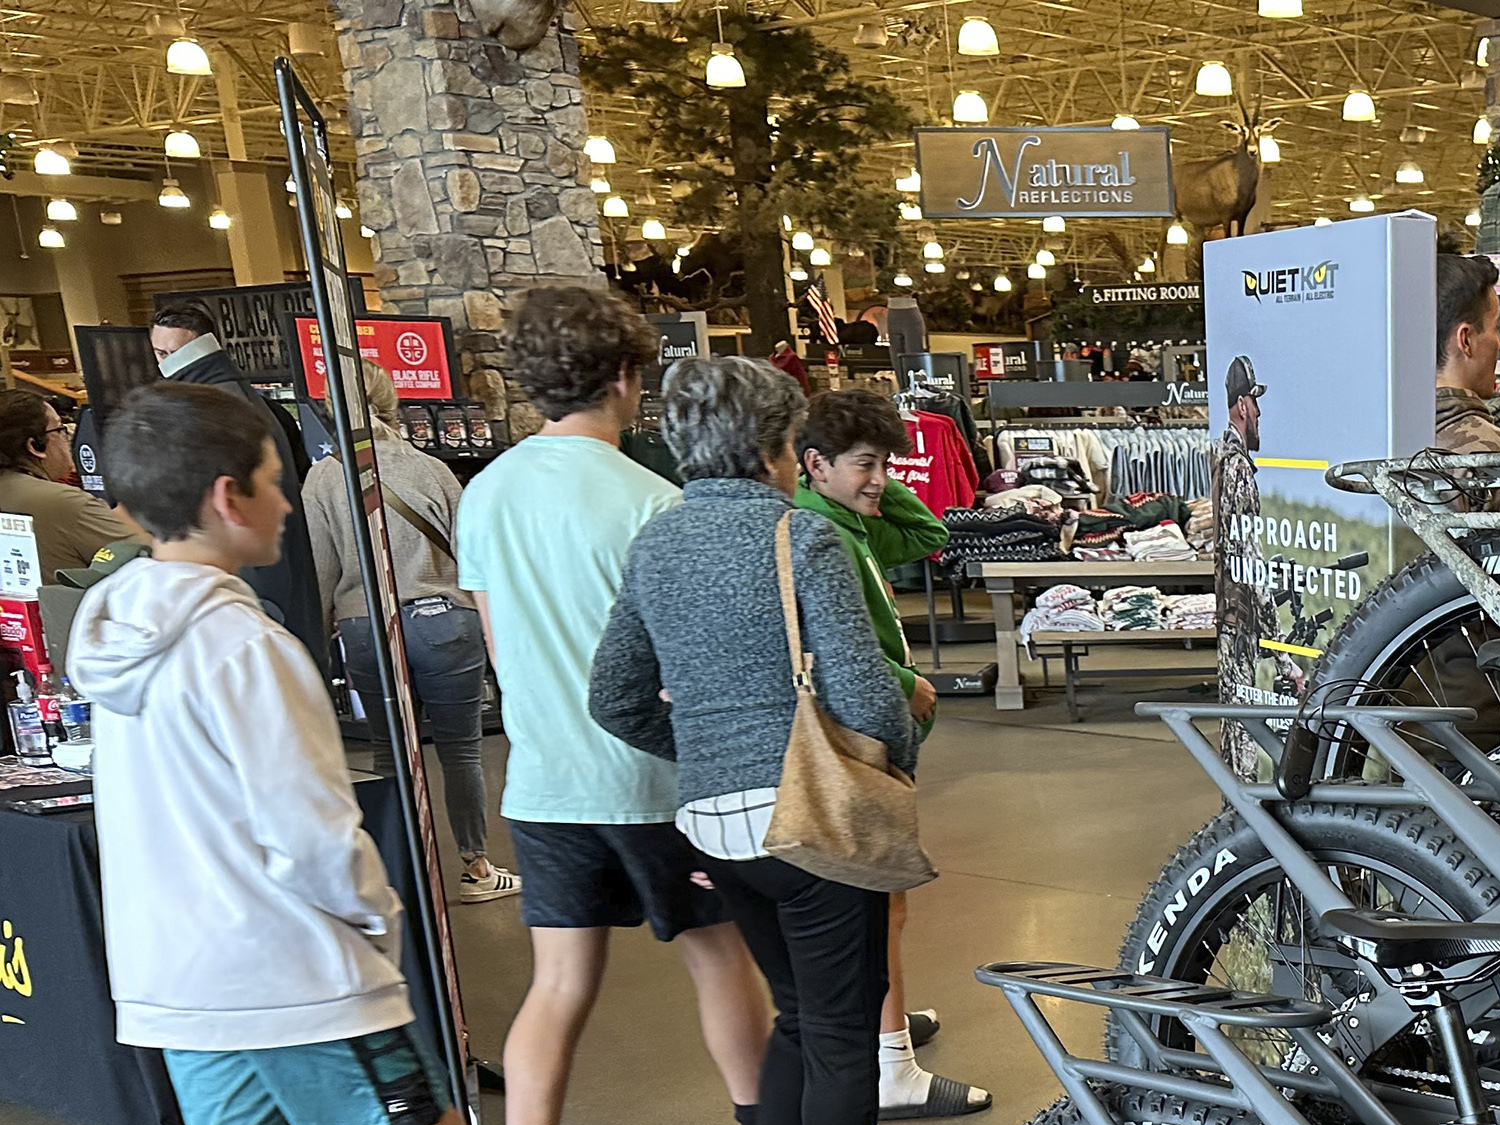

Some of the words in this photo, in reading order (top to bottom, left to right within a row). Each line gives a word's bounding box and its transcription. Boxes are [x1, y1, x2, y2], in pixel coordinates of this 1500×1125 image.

[956, 136, 1136, 210] Natural
[1019, 190, 1133, 203] REFLECTIONS
[1103, 289, 1157, 302] FITTING
[1241, 260, 1339, 304] QUIETKAT
[219, 294, 282, 339] BLACK
[392, 370, 417, 381] BLACK
[418, 370, 439, 381] RIFLE
[1162, 382, 1209, 406] Natur
[1229, 513, 1337, 553] APPROACH
[1230, 555, 1361, 601] UNDETECTED
[1236, 684, 1263, 704] BETTER
[1135, 848, 1238, 976] KENDA
